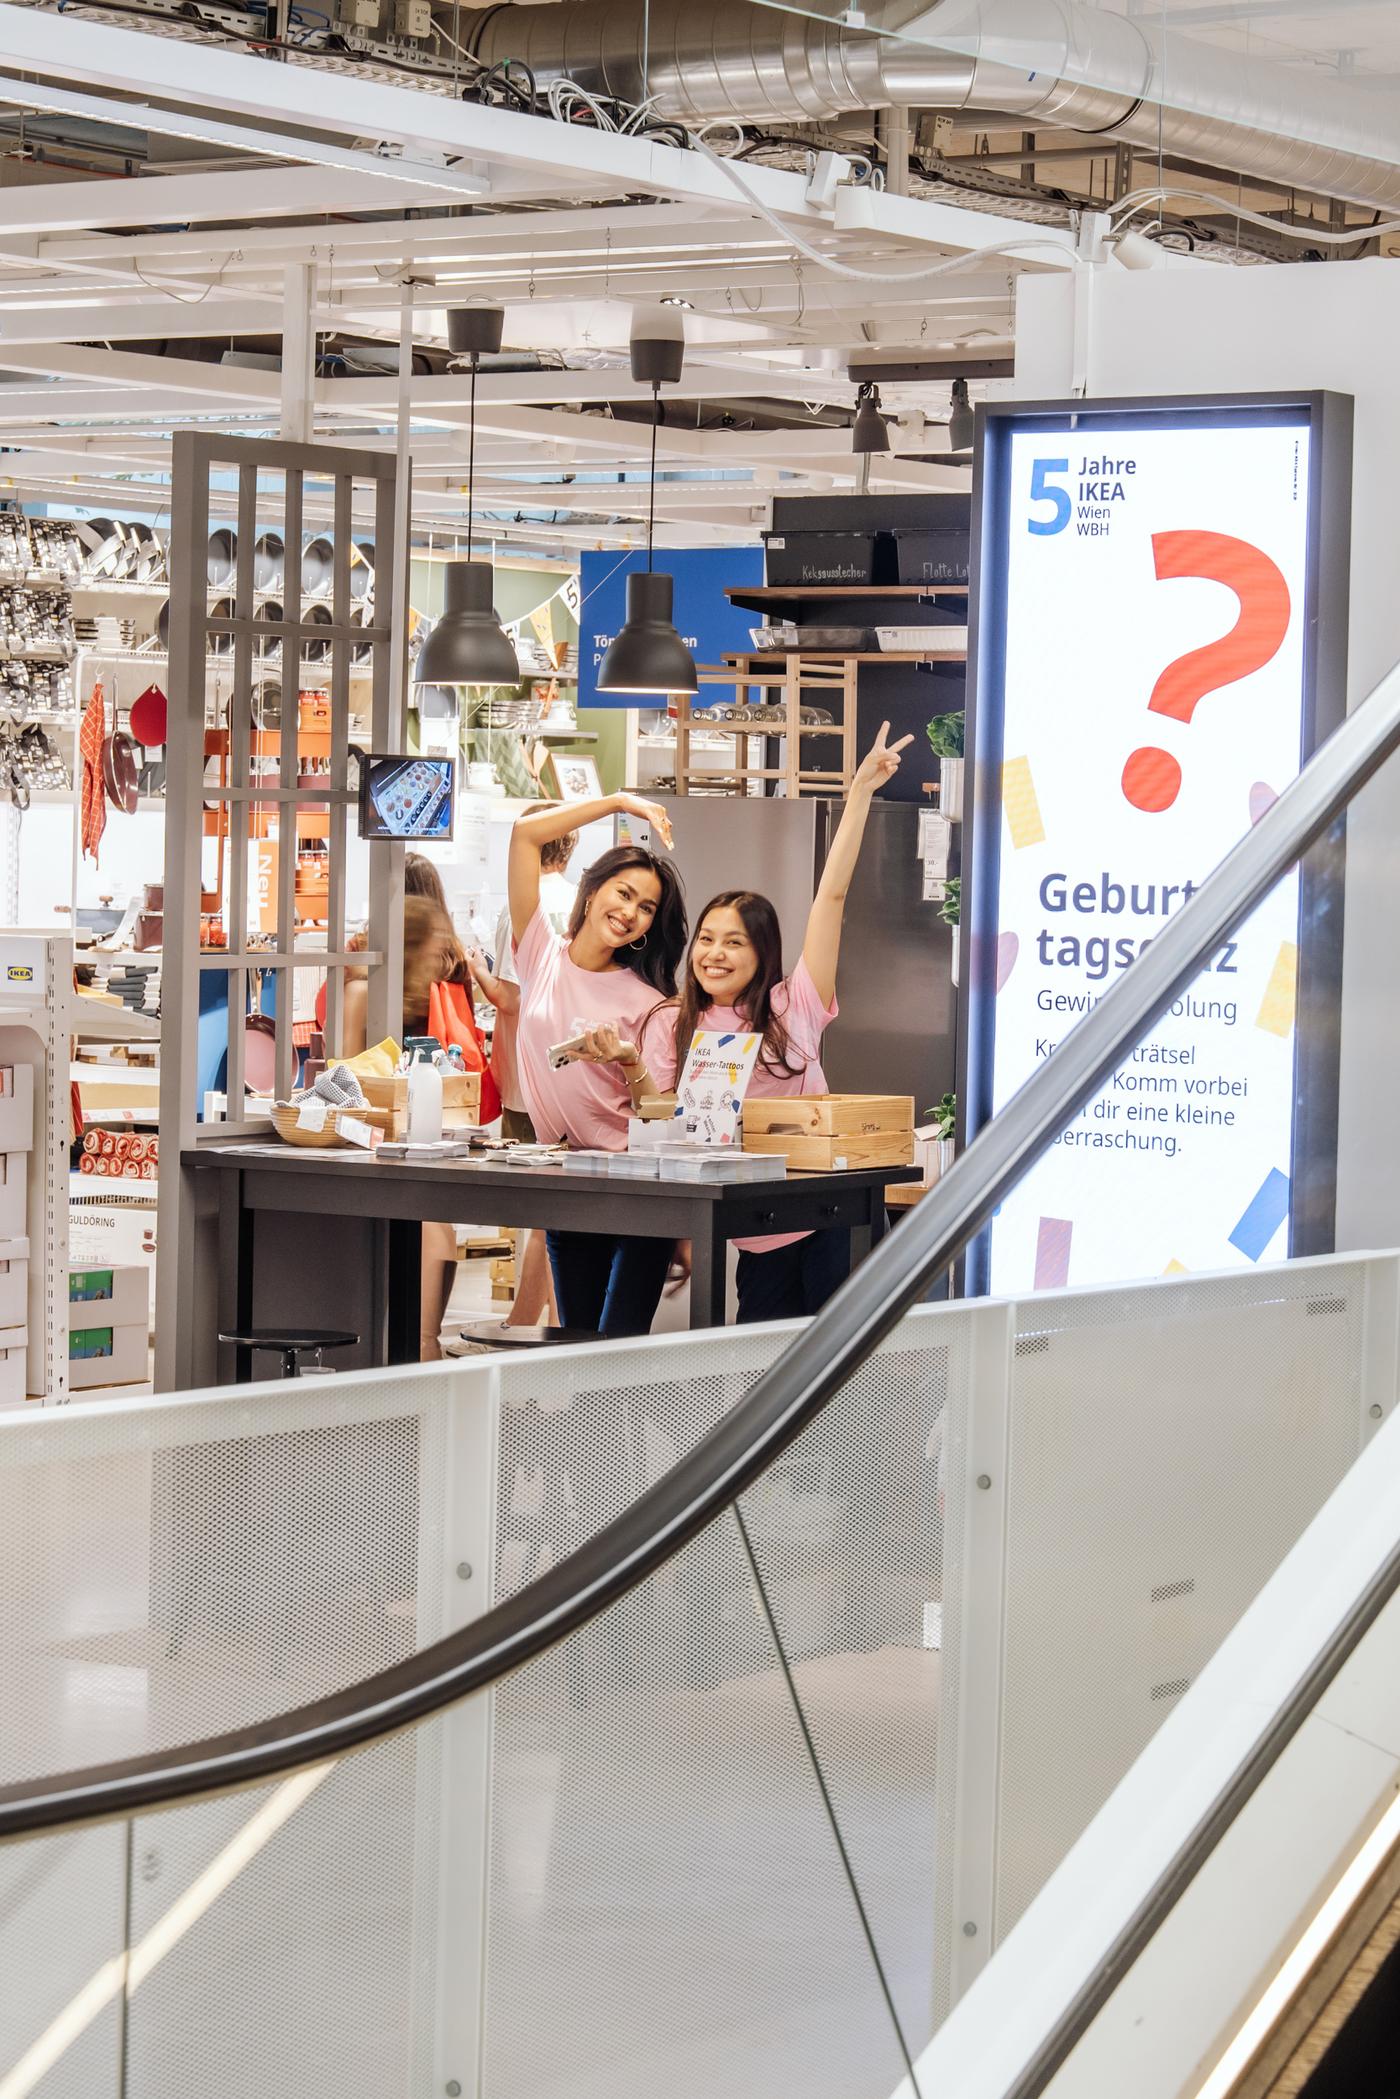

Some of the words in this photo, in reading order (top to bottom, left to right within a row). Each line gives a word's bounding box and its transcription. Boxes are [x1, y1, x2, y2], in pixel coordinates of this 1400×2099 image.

[1078, 455, 1137, 476] Jahre
[1028, 458, 1072, 536] 5
[1079, 482, 1126, 502] IKEA
[1077, 505, 1111, 519] Wien
[1077, 522, 1110, 537] WBH
[922, 561, 953, 579] Flotte
[566, 583, 578, 609] 5
[259, 854, 273, 908] Neu
[1039, 872, 1201, 916] Geburt
[1036, 929, 1238, 980] tagsz
[694, 1048, 711, 1057] IKEA
[692, 1059, 745, 1071] Wasser-Tattoos
[1113, 1071, 1177, 1093] Komm
[1184, 1075, 1248, 1097] vorbei
[1093, 1099, 1121, 1119] dir
[1127, 1102, 1169, 1122] eine
[1175, 1103, 1235, 1126] kleine
[69, 1214, 116, 1228] GULDÖRING
